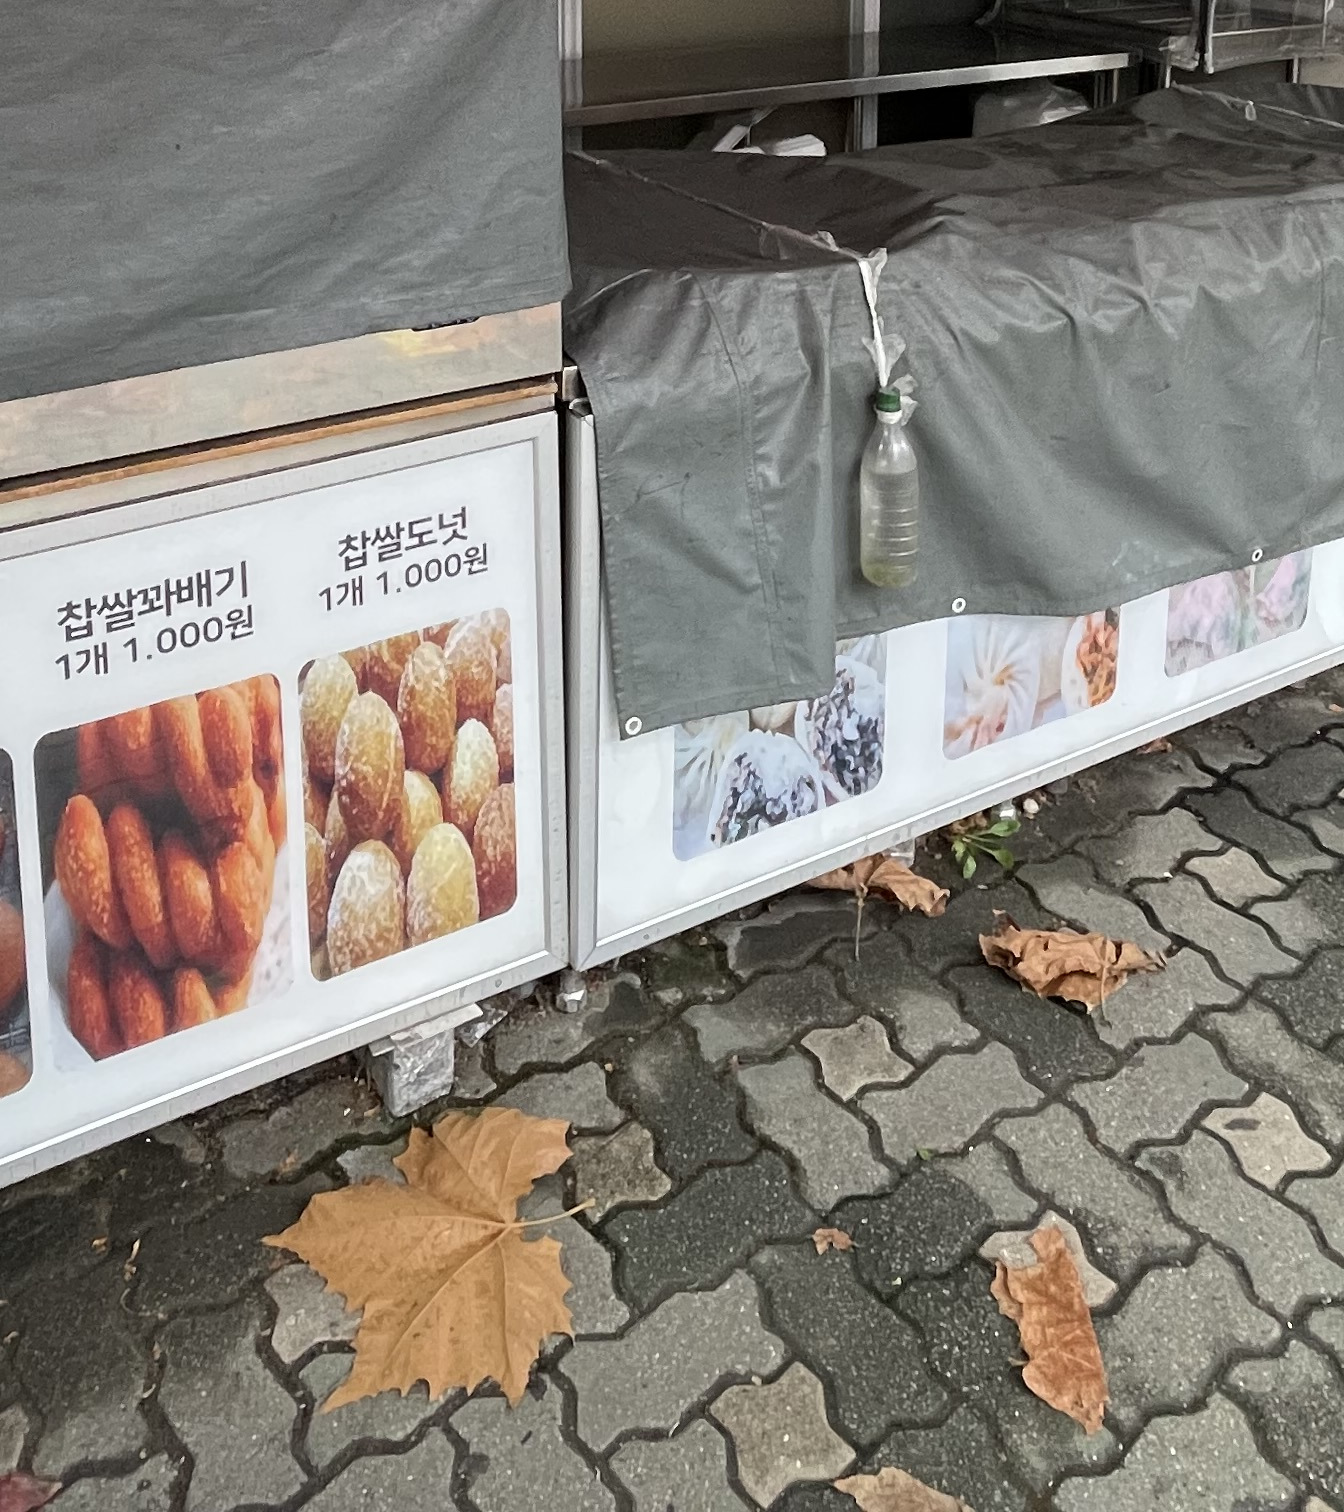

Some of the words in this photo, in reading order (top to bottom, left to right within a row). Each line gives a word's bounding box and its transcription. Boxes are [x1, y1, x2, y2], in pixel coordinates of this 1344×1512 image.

[337, 507, 470, 572] 찹쌀도넛
[56, 560, 250, 642] 찹쌀꽈배기
[318, 577, 364, 613] 1개
[376, 543, 490, 597] 1.000원
[54, 641, 109, 681] 1개
[123, 605, 254, 665] 1.000원
